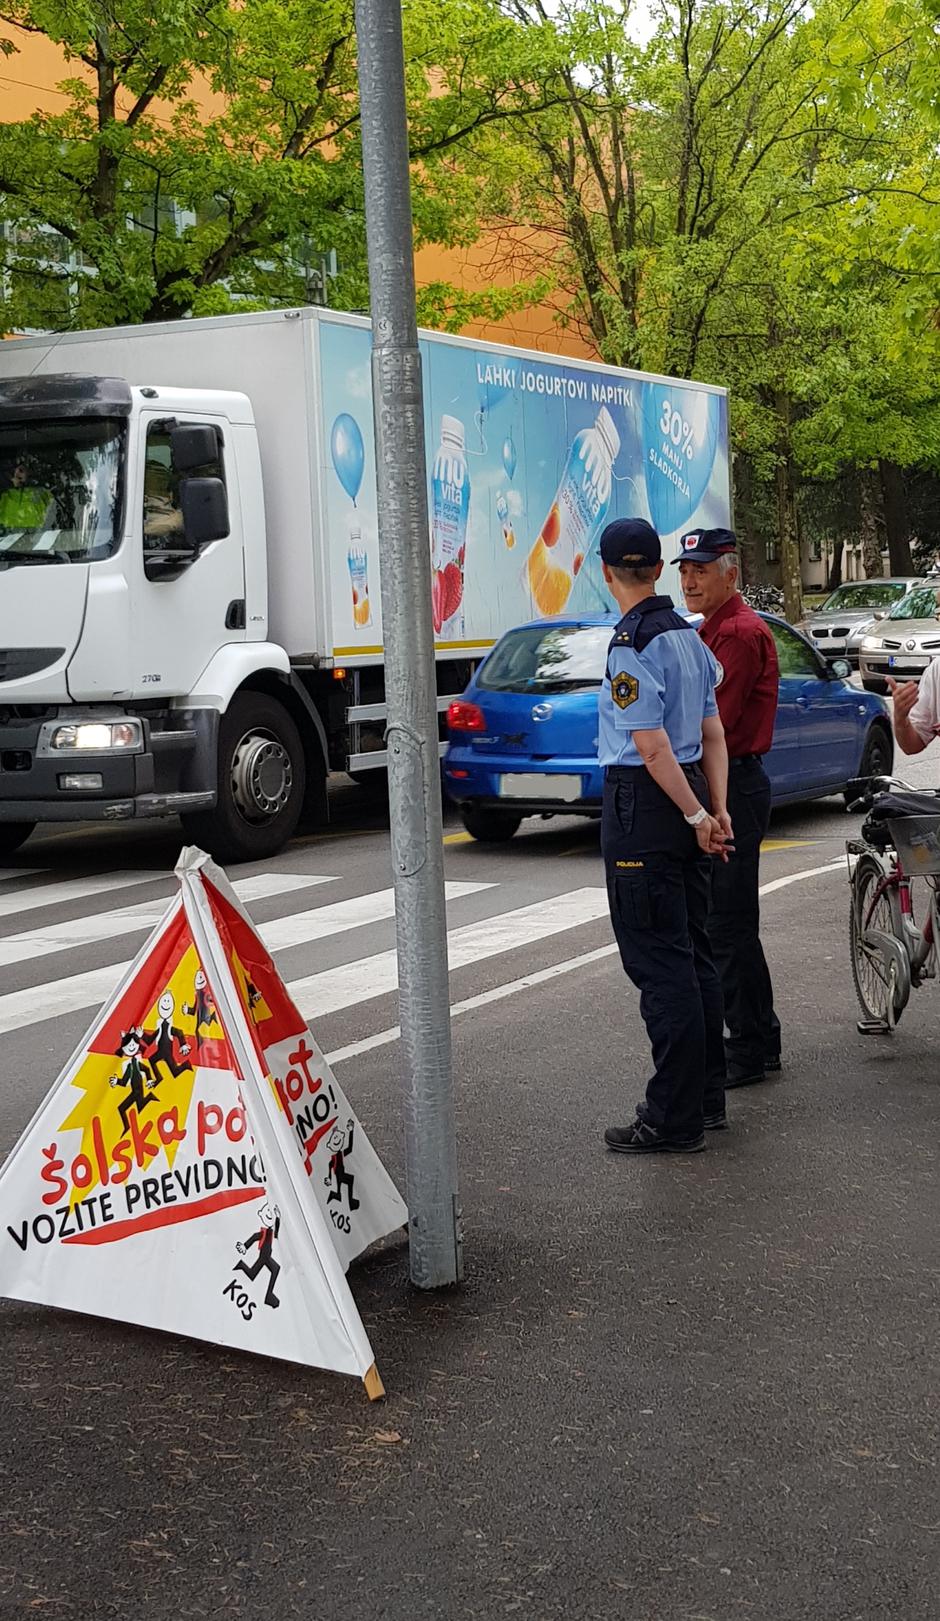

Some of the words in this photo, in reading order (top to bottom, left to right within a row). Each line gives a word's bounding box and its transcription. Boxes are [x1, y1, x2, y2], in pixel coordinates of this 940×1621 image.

[477, 363, 516, 389] LAHKI
[520, 371, 587, 400] JOGURTOVI
[591, 383, 634, 407] NAPITKI
[660, 400, 694, 460] 30%
[649, 447, 691, 499] SLADKORJA
[662, 442, 684, 470] MANJ
[441, 482, 463, 506] vita
[582, 472, 601, 517] vita
[41, 1106, 187, 1205] šolska
[7, 1192, 116, 1251] VOZITE
[329, 1209, 351, 1235] KOS
[222, 1279, 258, 1321] KOS
